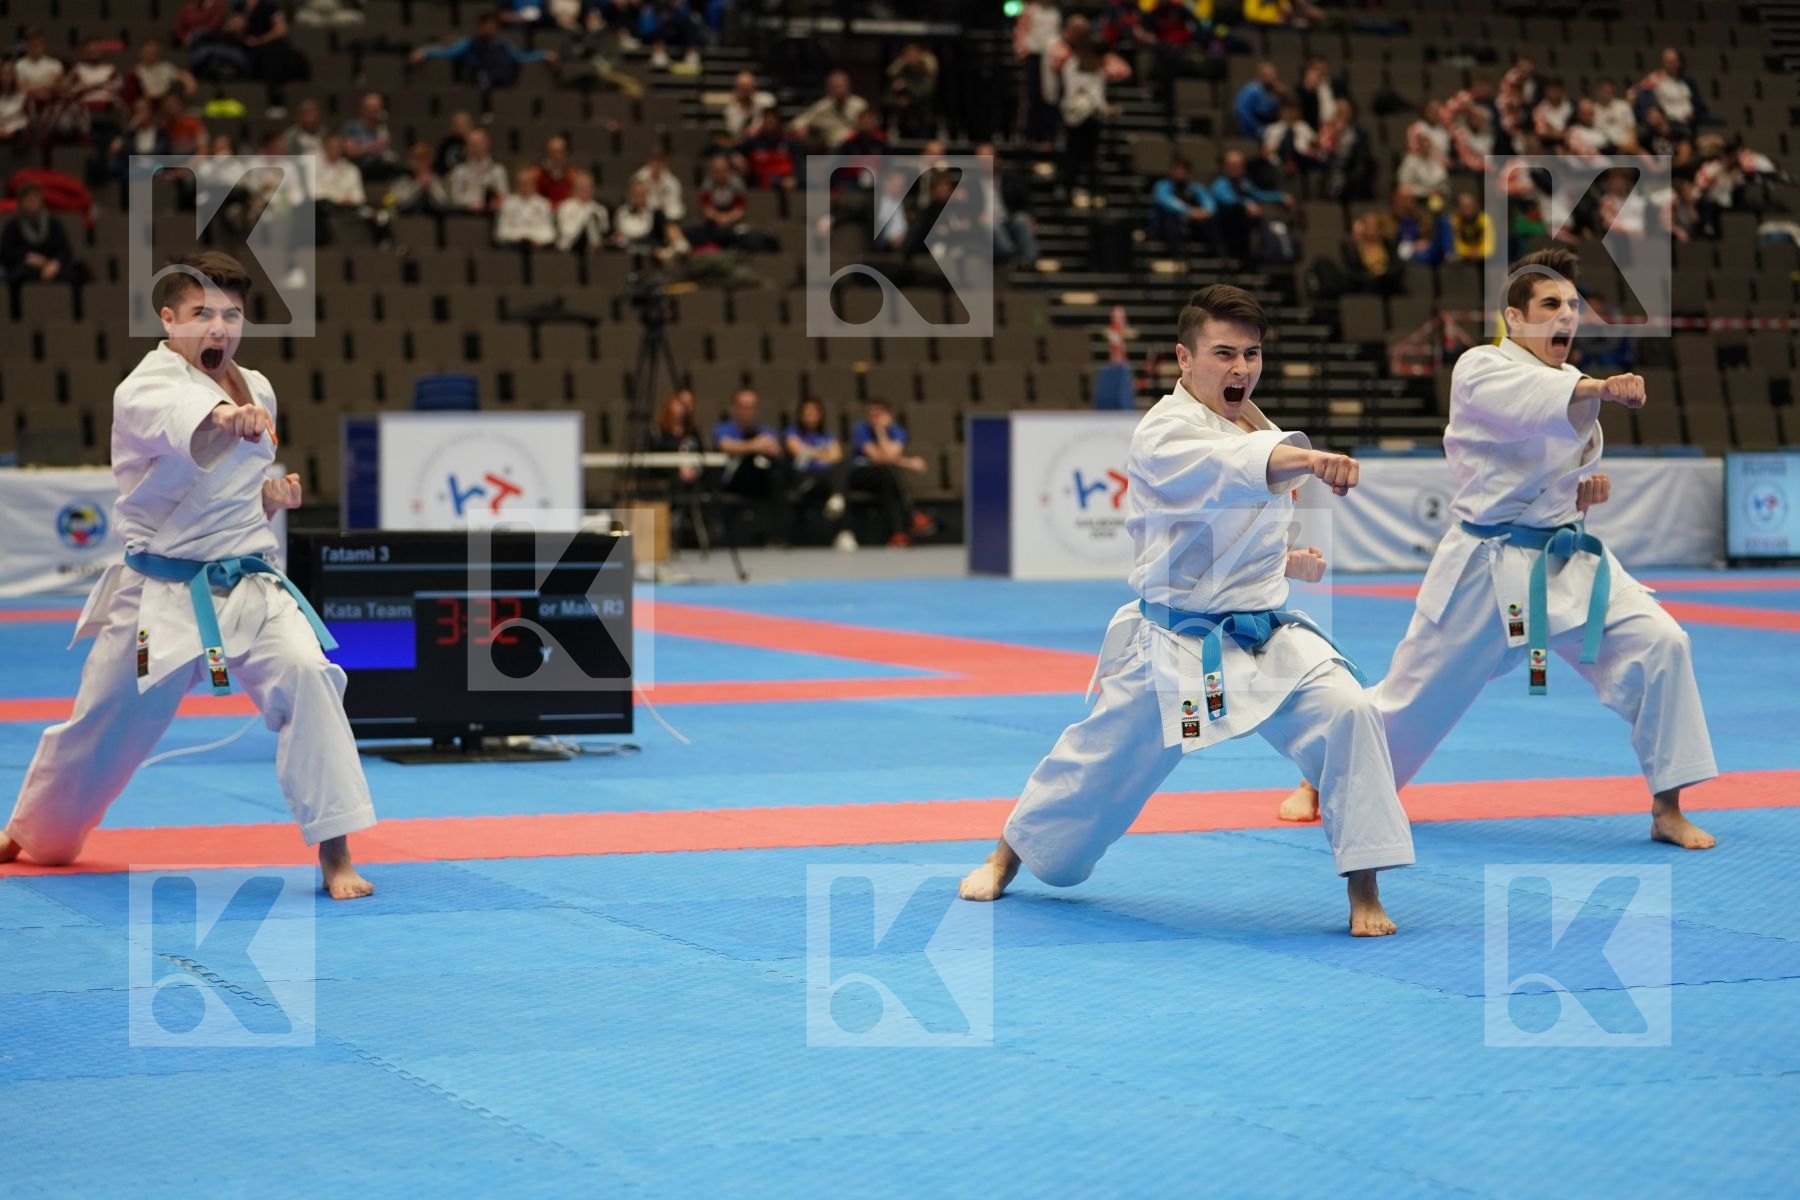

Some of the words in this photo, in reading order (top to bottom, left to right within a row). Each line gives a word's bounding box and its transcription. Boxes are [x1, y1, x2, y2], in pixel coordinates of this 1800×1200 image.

[379, 546, 390, 562] 3
[324, 602, 362, 618] Kata
[366, 602, 412, 618] Team
